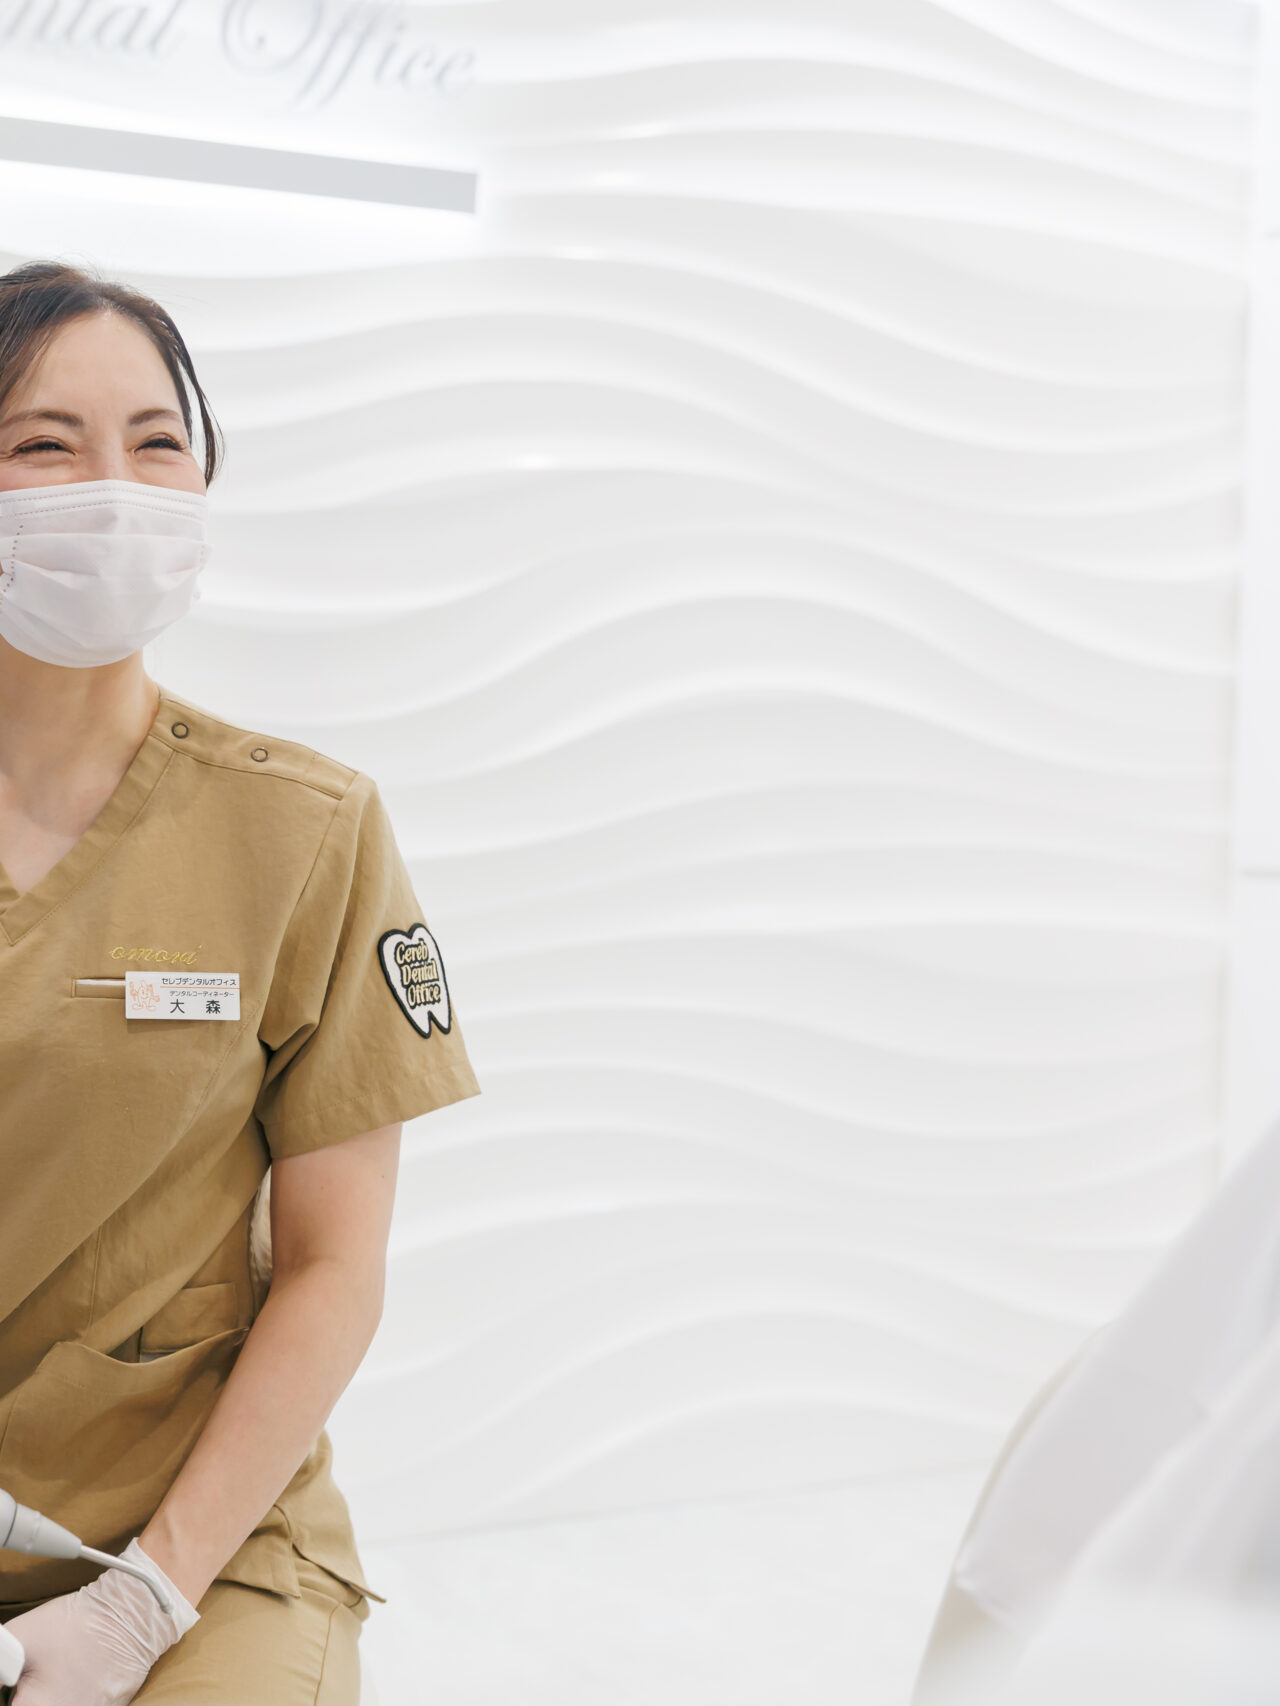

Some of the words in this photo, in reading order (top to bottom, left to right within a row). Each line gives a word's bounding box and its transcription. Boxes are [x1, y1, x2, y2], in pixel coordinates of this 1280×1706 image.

[220, 0, 477, 112] Office
[161, 977, 237, 986] セレブデンタルオフィス
[401, 958, 439, 987] Dental
[407, 984, 441, 1008] Office
